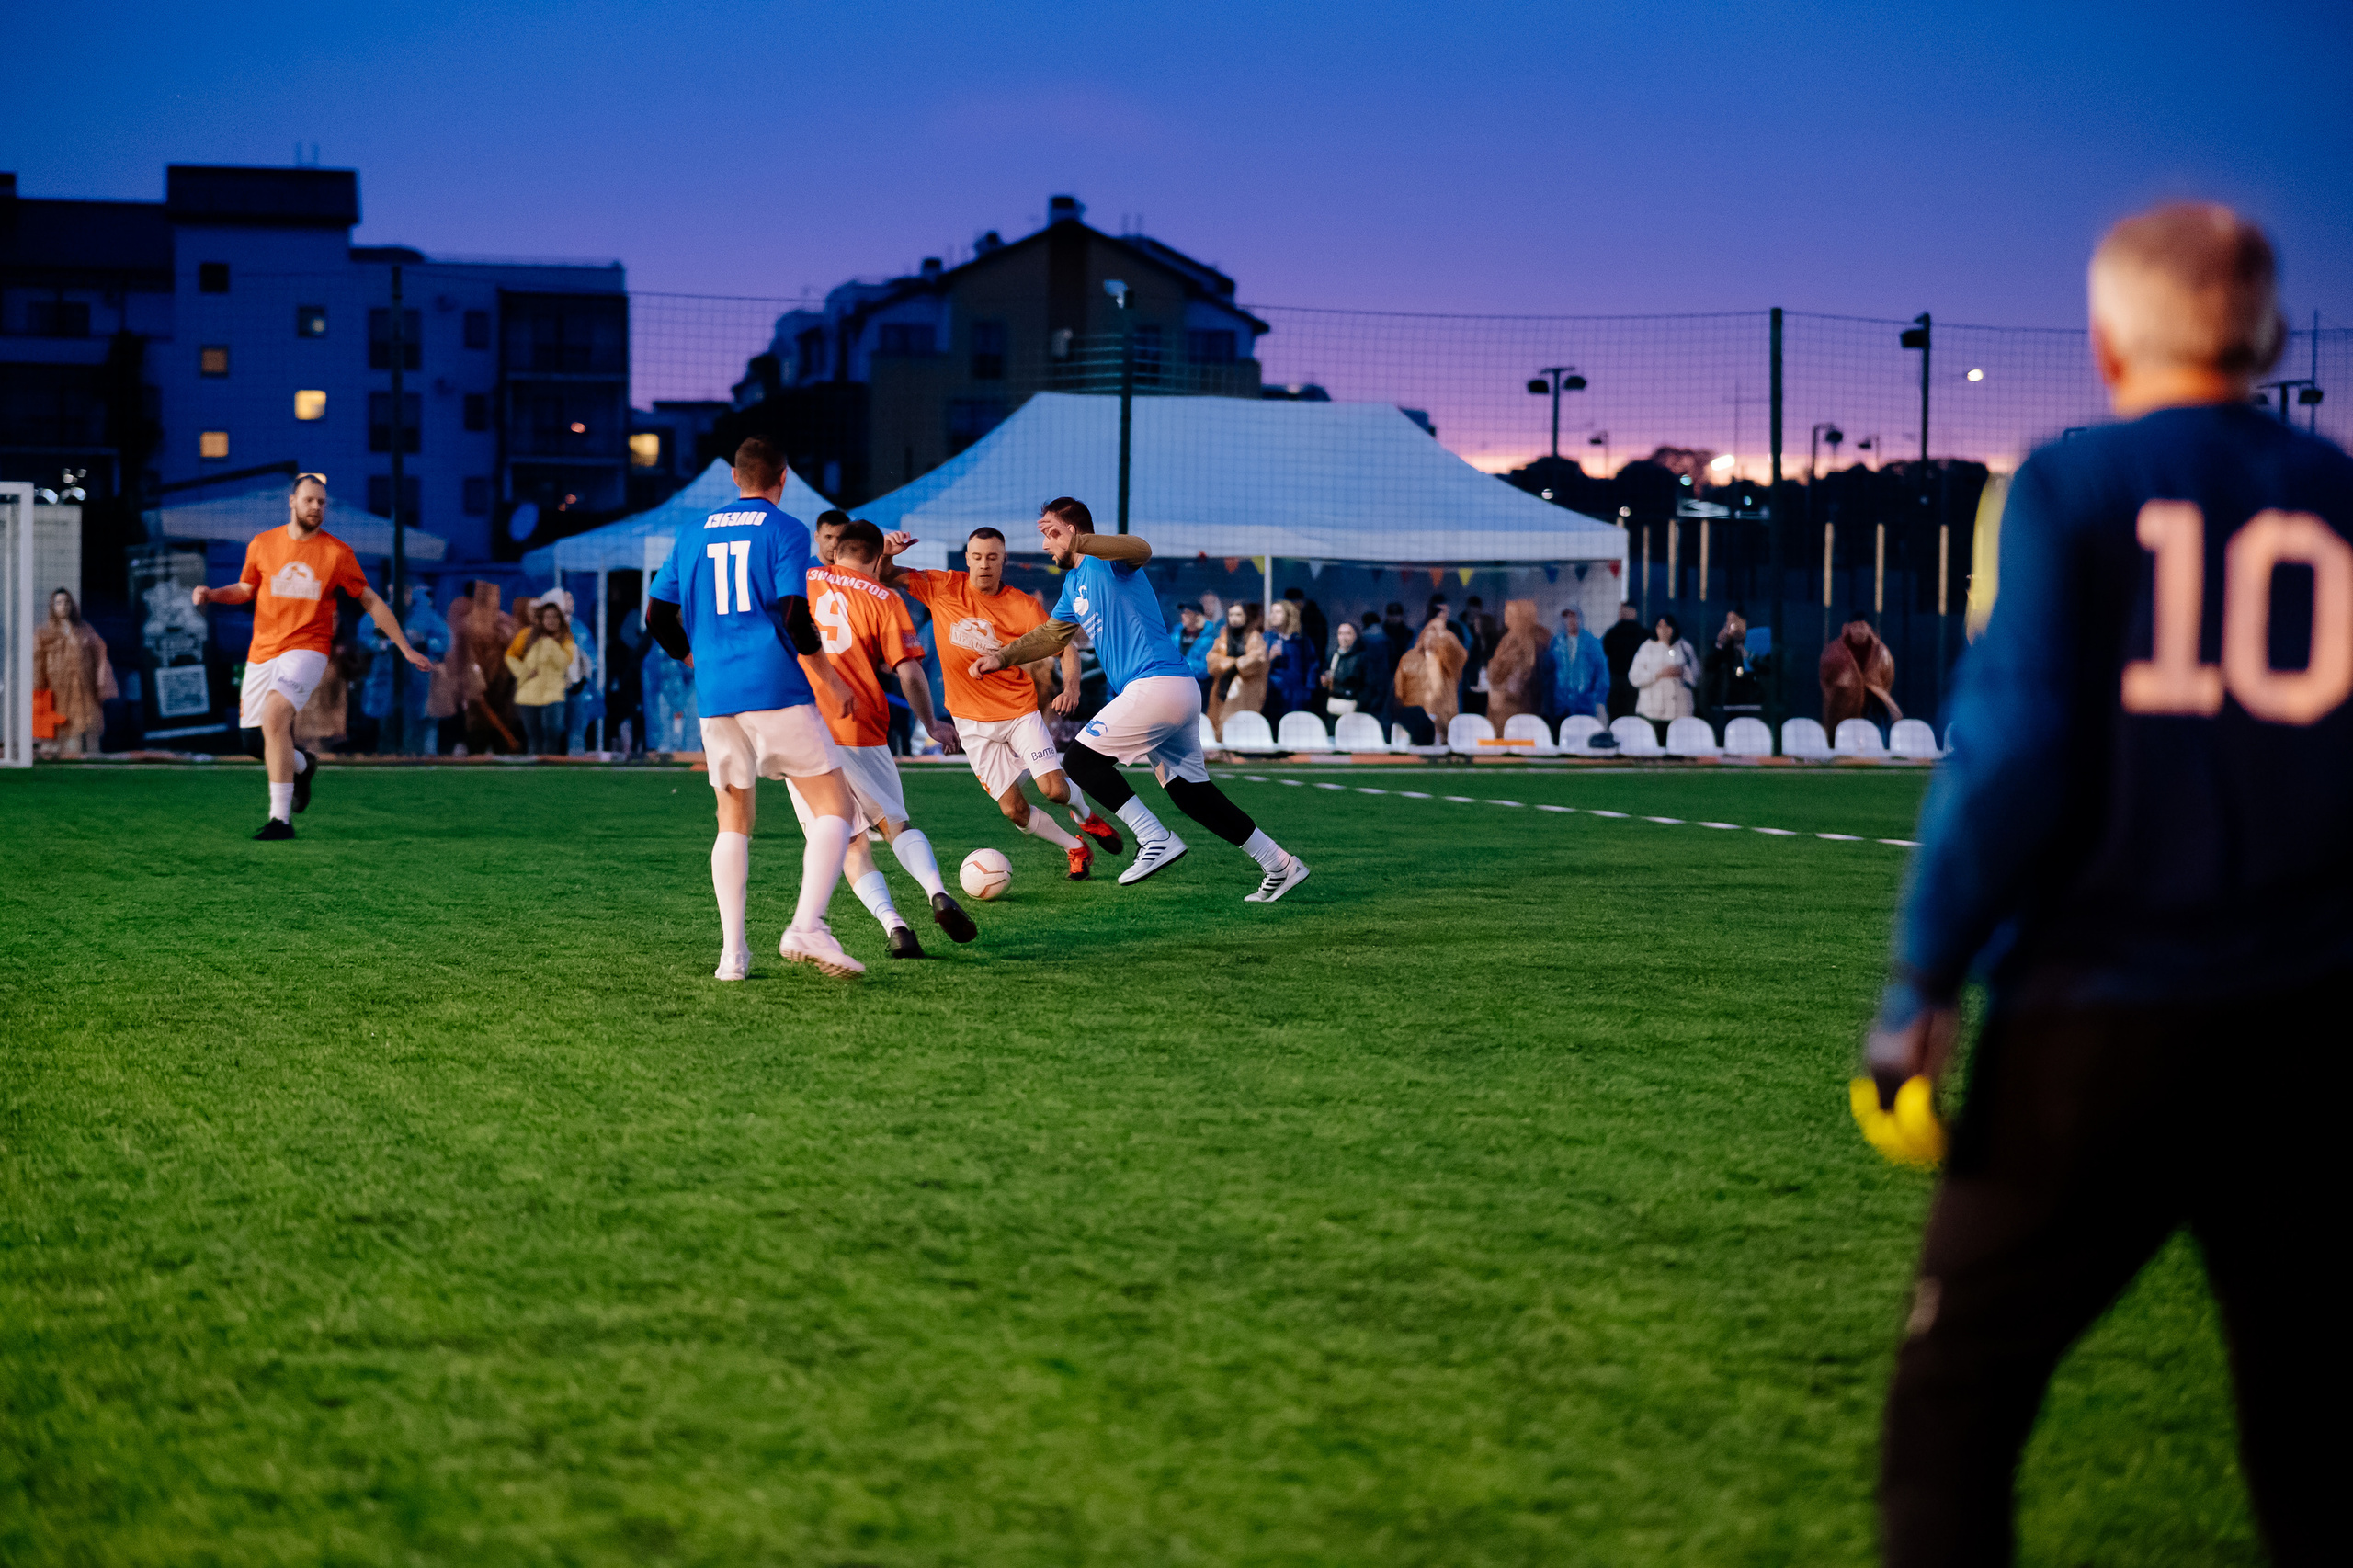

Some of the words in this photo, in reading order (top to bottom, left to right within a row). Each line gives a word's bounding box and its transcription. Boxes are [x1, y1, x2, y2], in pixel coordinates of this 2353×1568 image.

[707, 540, 751, 615] 11
[2120, 497, 2353, 727] 10
[814, 589, 852, 654] 9
[1030, 746, 1055, 761] Валта
